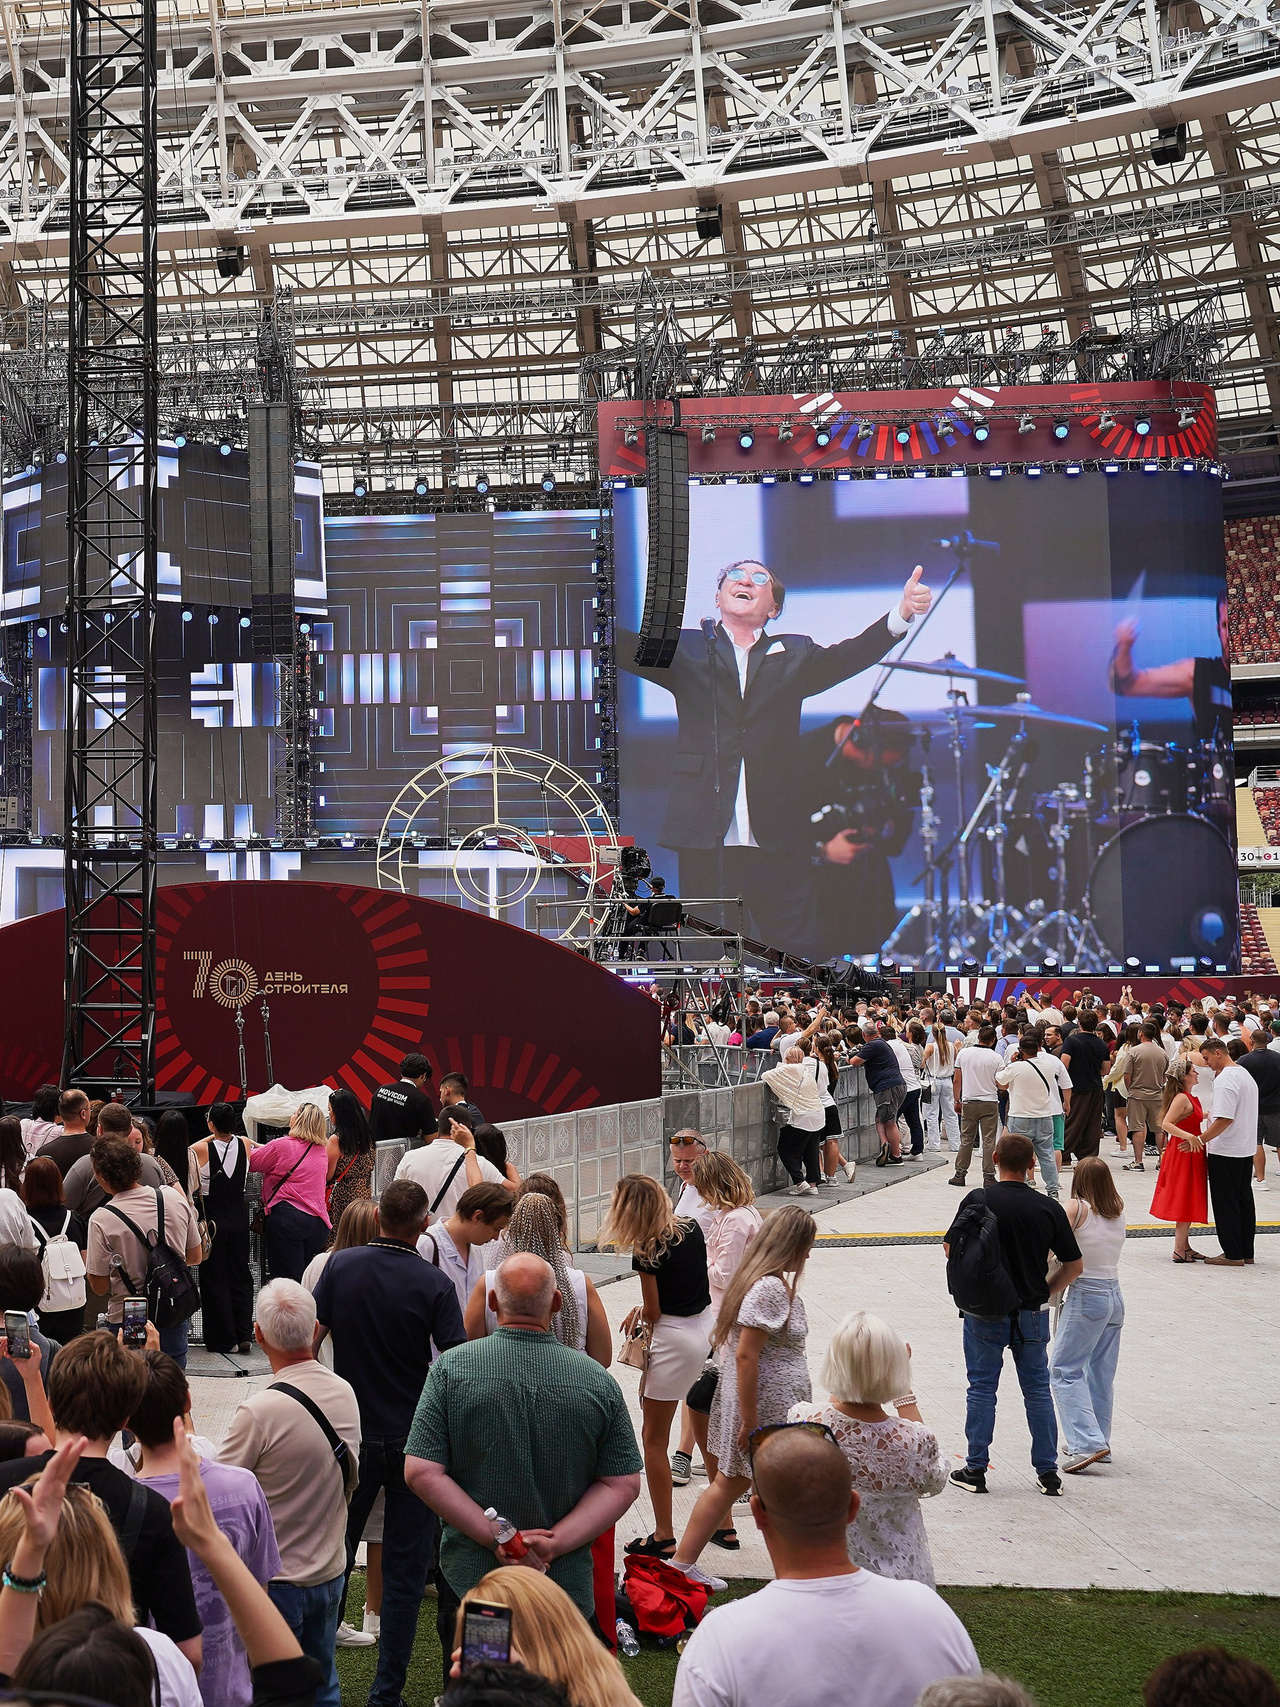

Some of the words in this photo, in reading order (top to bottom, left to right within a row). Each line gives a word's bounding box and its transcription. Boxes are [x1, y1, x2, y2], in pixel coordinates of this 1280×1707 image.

[183, 951, 258, 1008] 70
[264, 971, 303, 981] ДЕНЬ
[264, 984, 348, 994] СТРОИТЕЛЯ
[378, 1088, 408, 1102] MOVICOM
